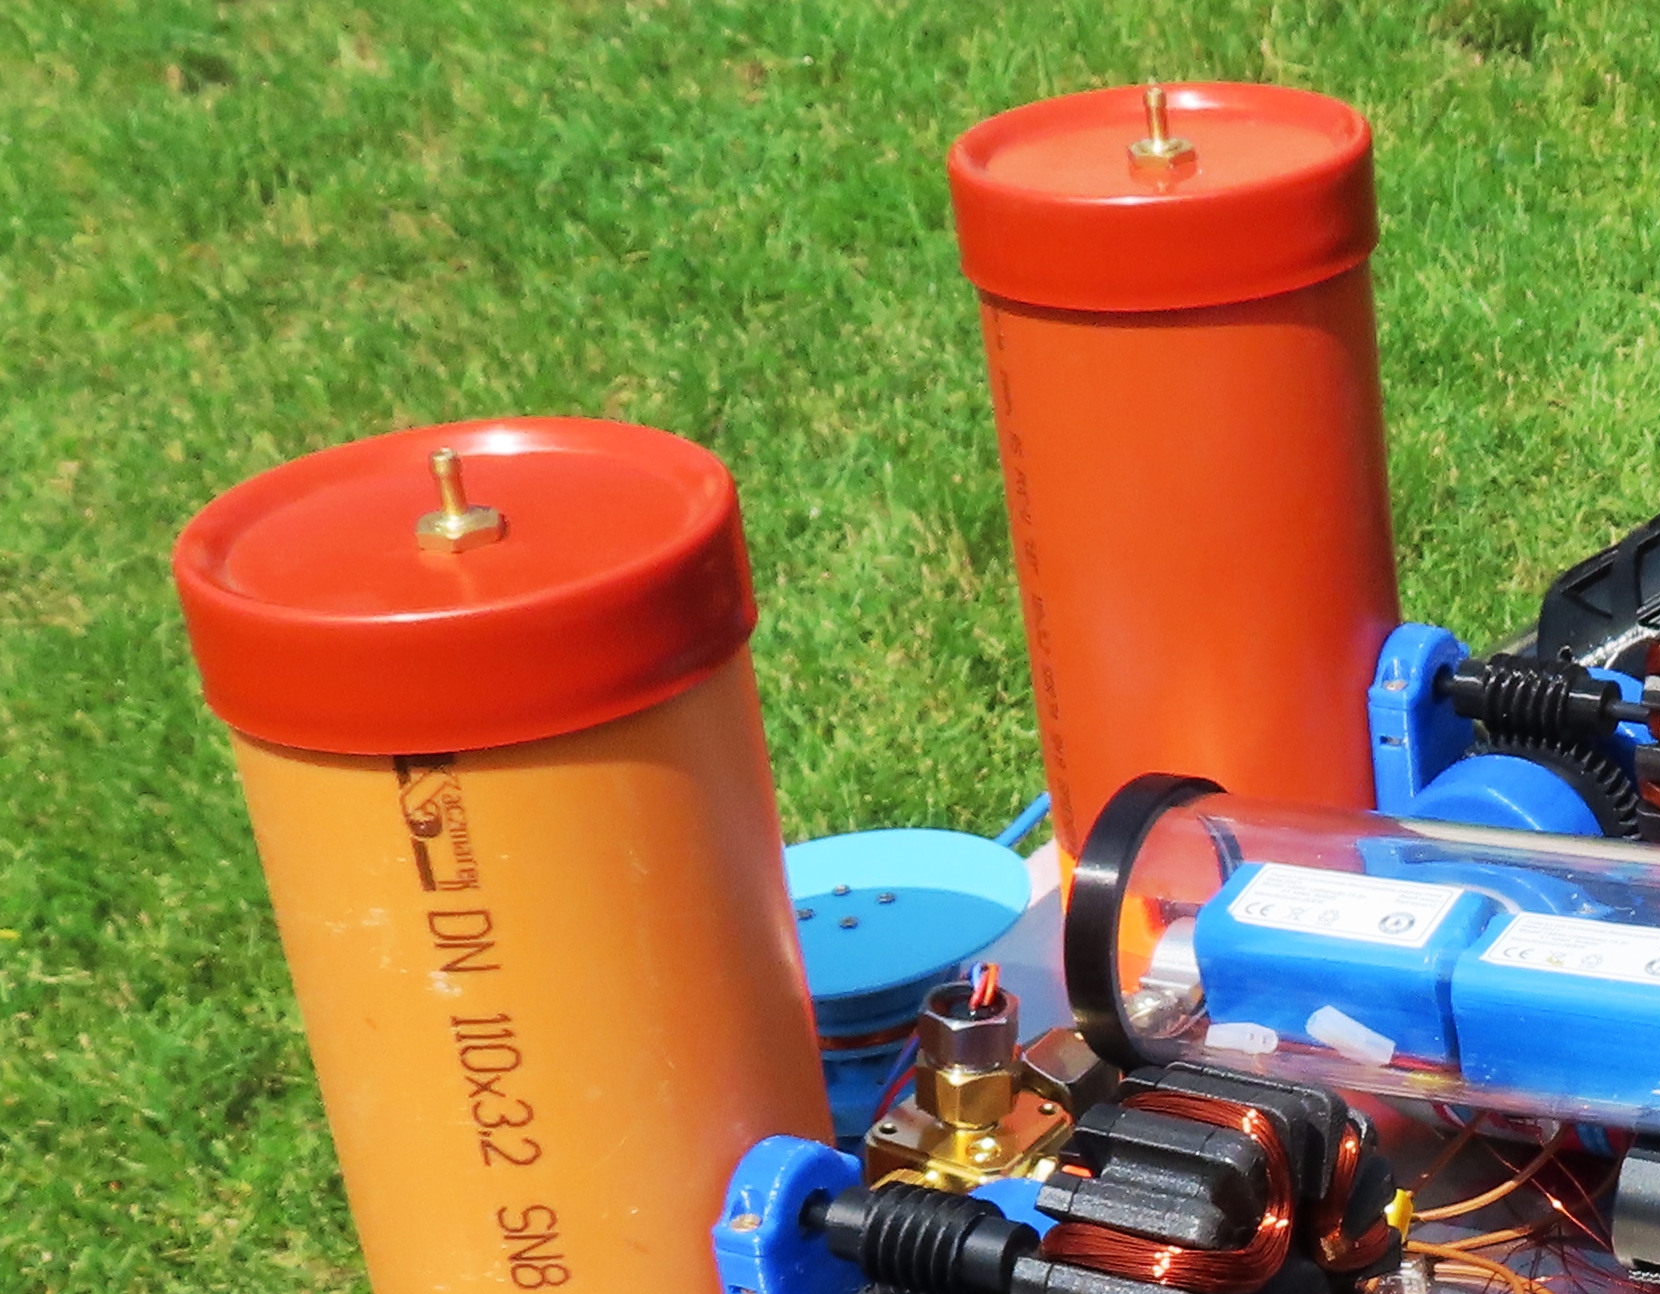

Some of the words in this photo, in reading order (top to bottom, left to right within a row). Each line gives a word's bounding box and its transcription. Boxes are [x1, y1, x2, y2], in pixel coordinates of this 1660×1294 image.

[1245, 902, 1276, 917] CE
[1503, 946, 1534, 960] CE
[427, 910, 502, 975] DN
[496, 1204, 573, 1292] SN8
